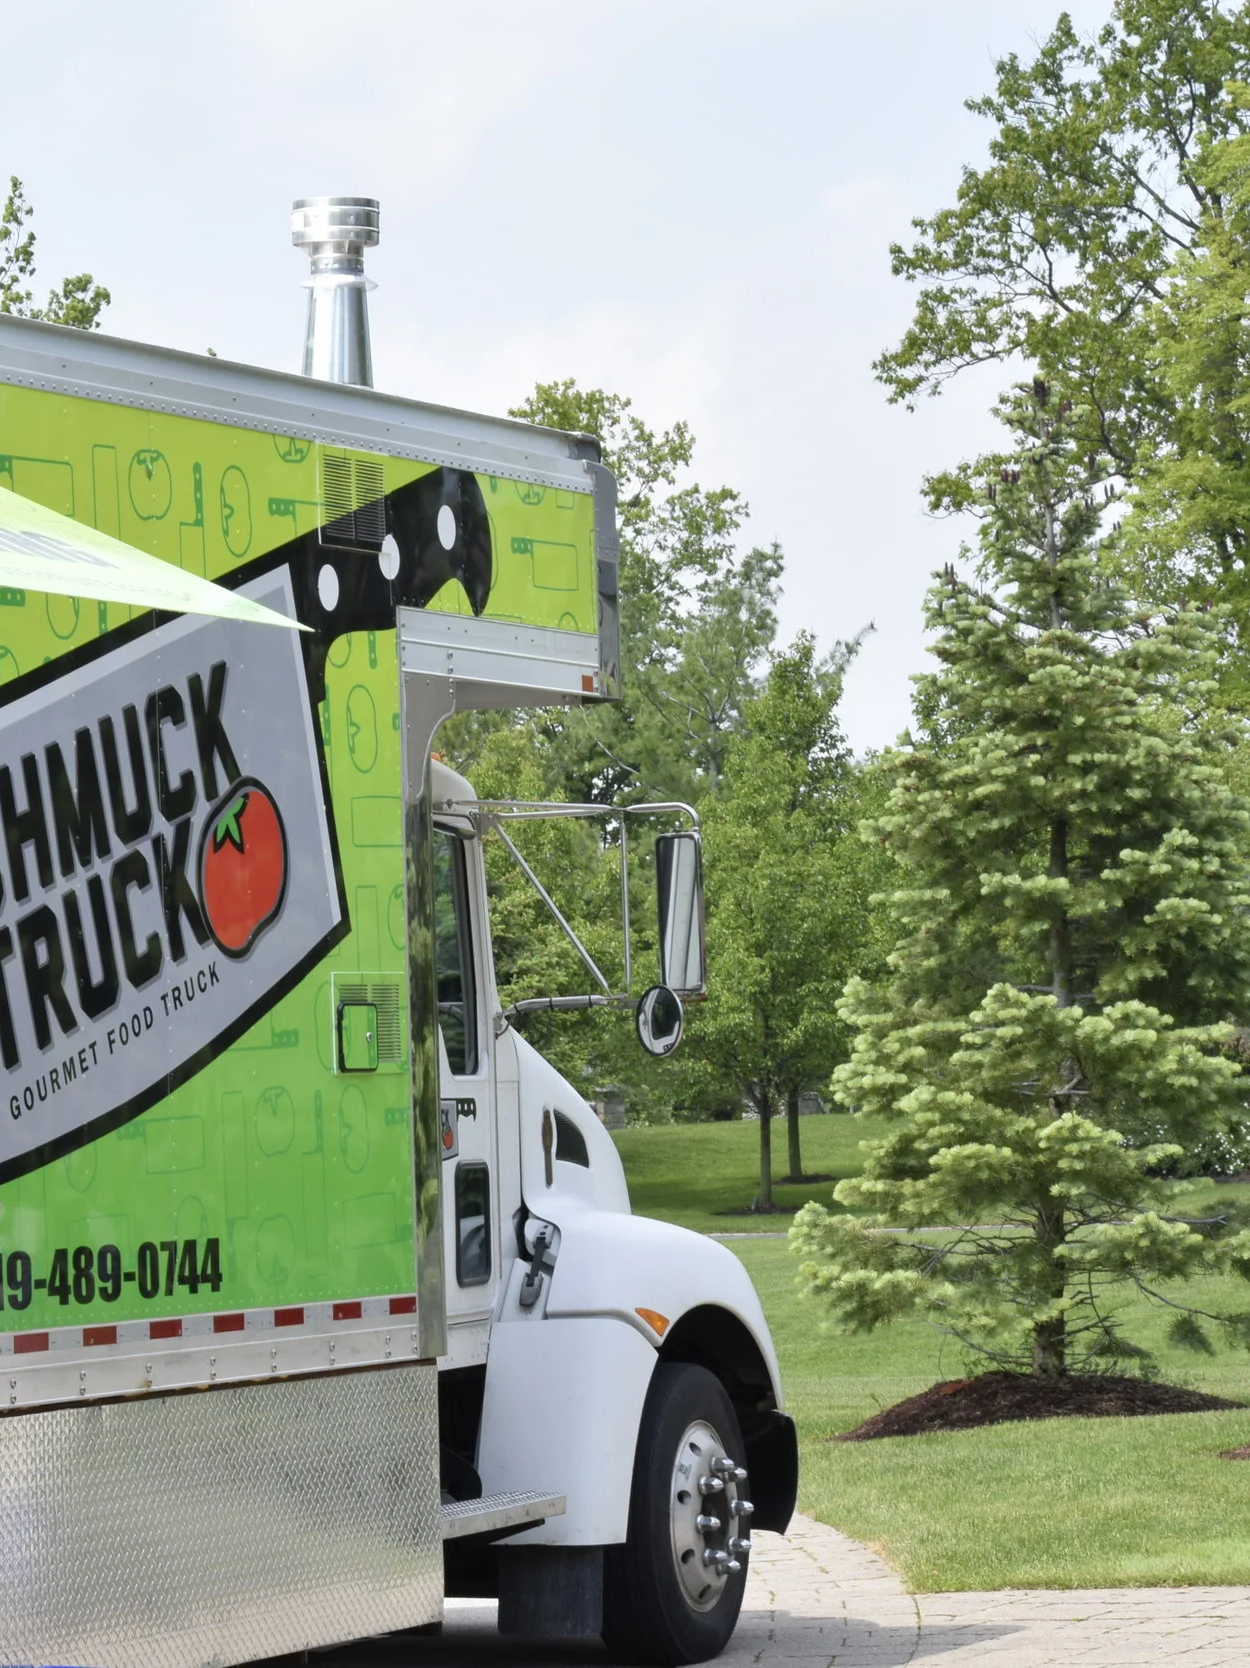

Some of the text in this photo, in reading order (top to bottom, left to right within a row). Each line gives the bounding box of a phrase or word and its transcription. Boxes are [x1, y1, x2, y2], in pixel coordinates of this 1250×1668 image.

[9, 960, 220, 1121] GOURMET FOOD TRUCK
